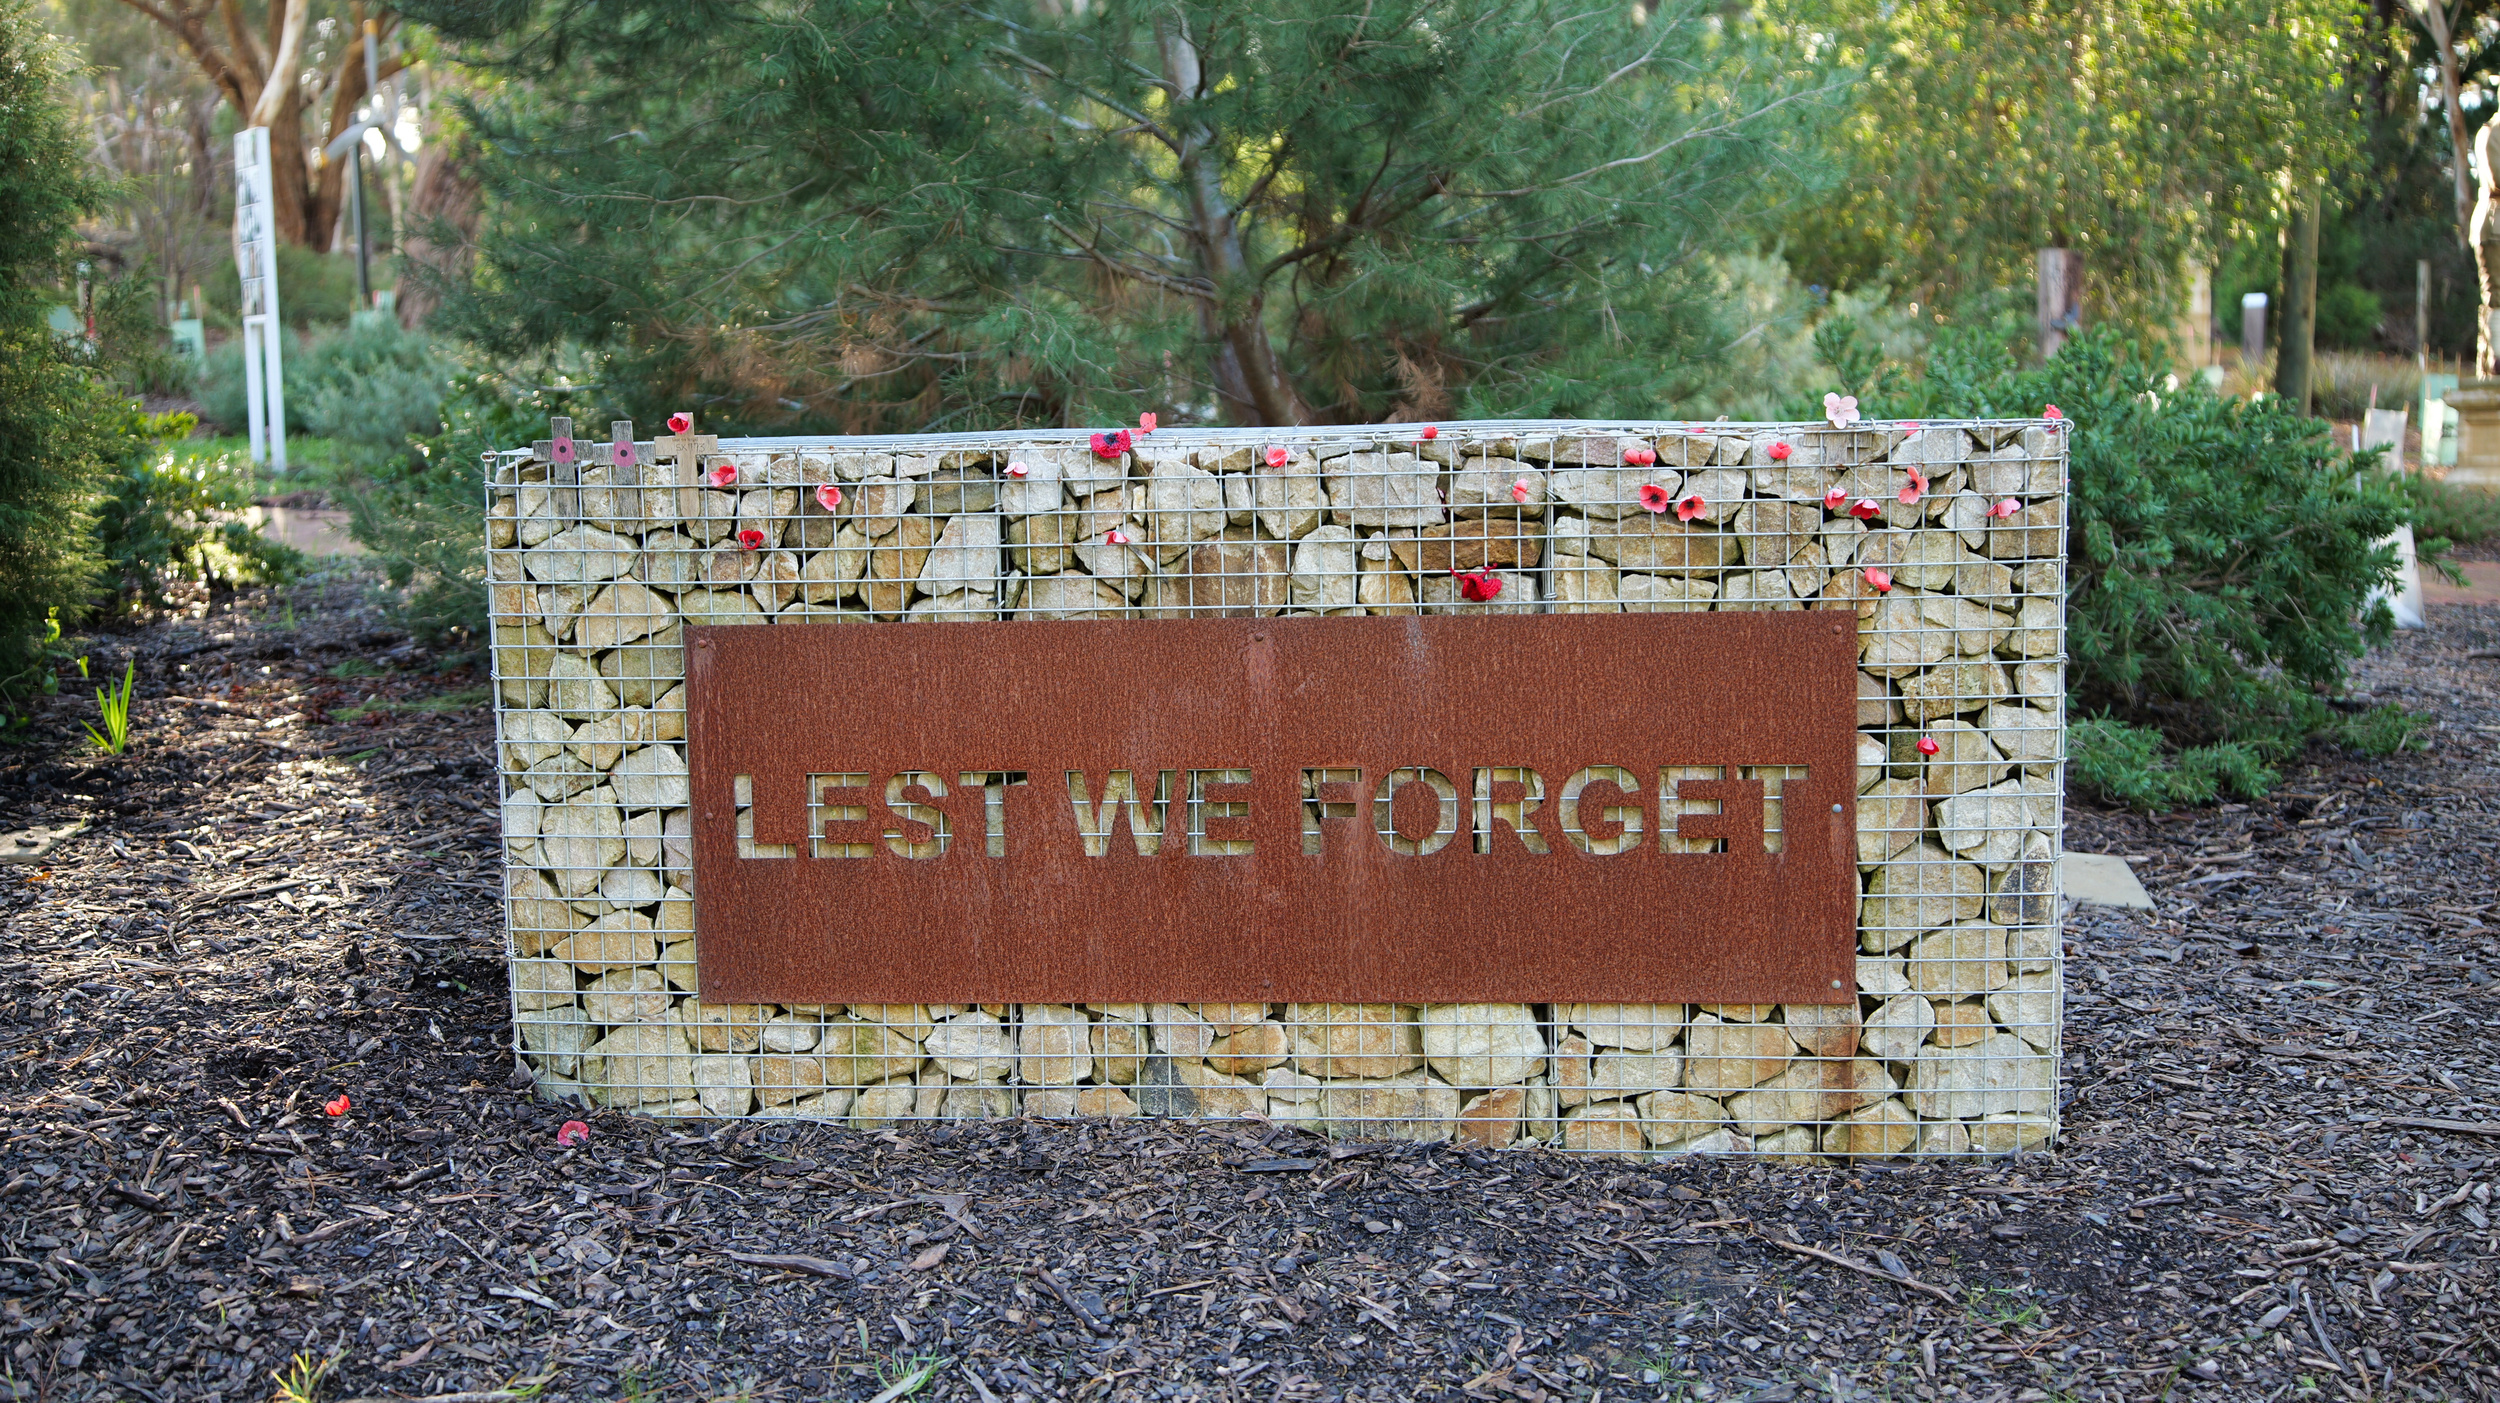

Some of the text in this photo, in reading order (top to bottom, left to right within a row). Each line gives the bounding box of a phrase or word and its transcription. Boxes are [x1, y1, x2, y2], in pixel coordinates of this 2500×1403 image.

[734, 764, 1811, 859] LEST WE FORGET
